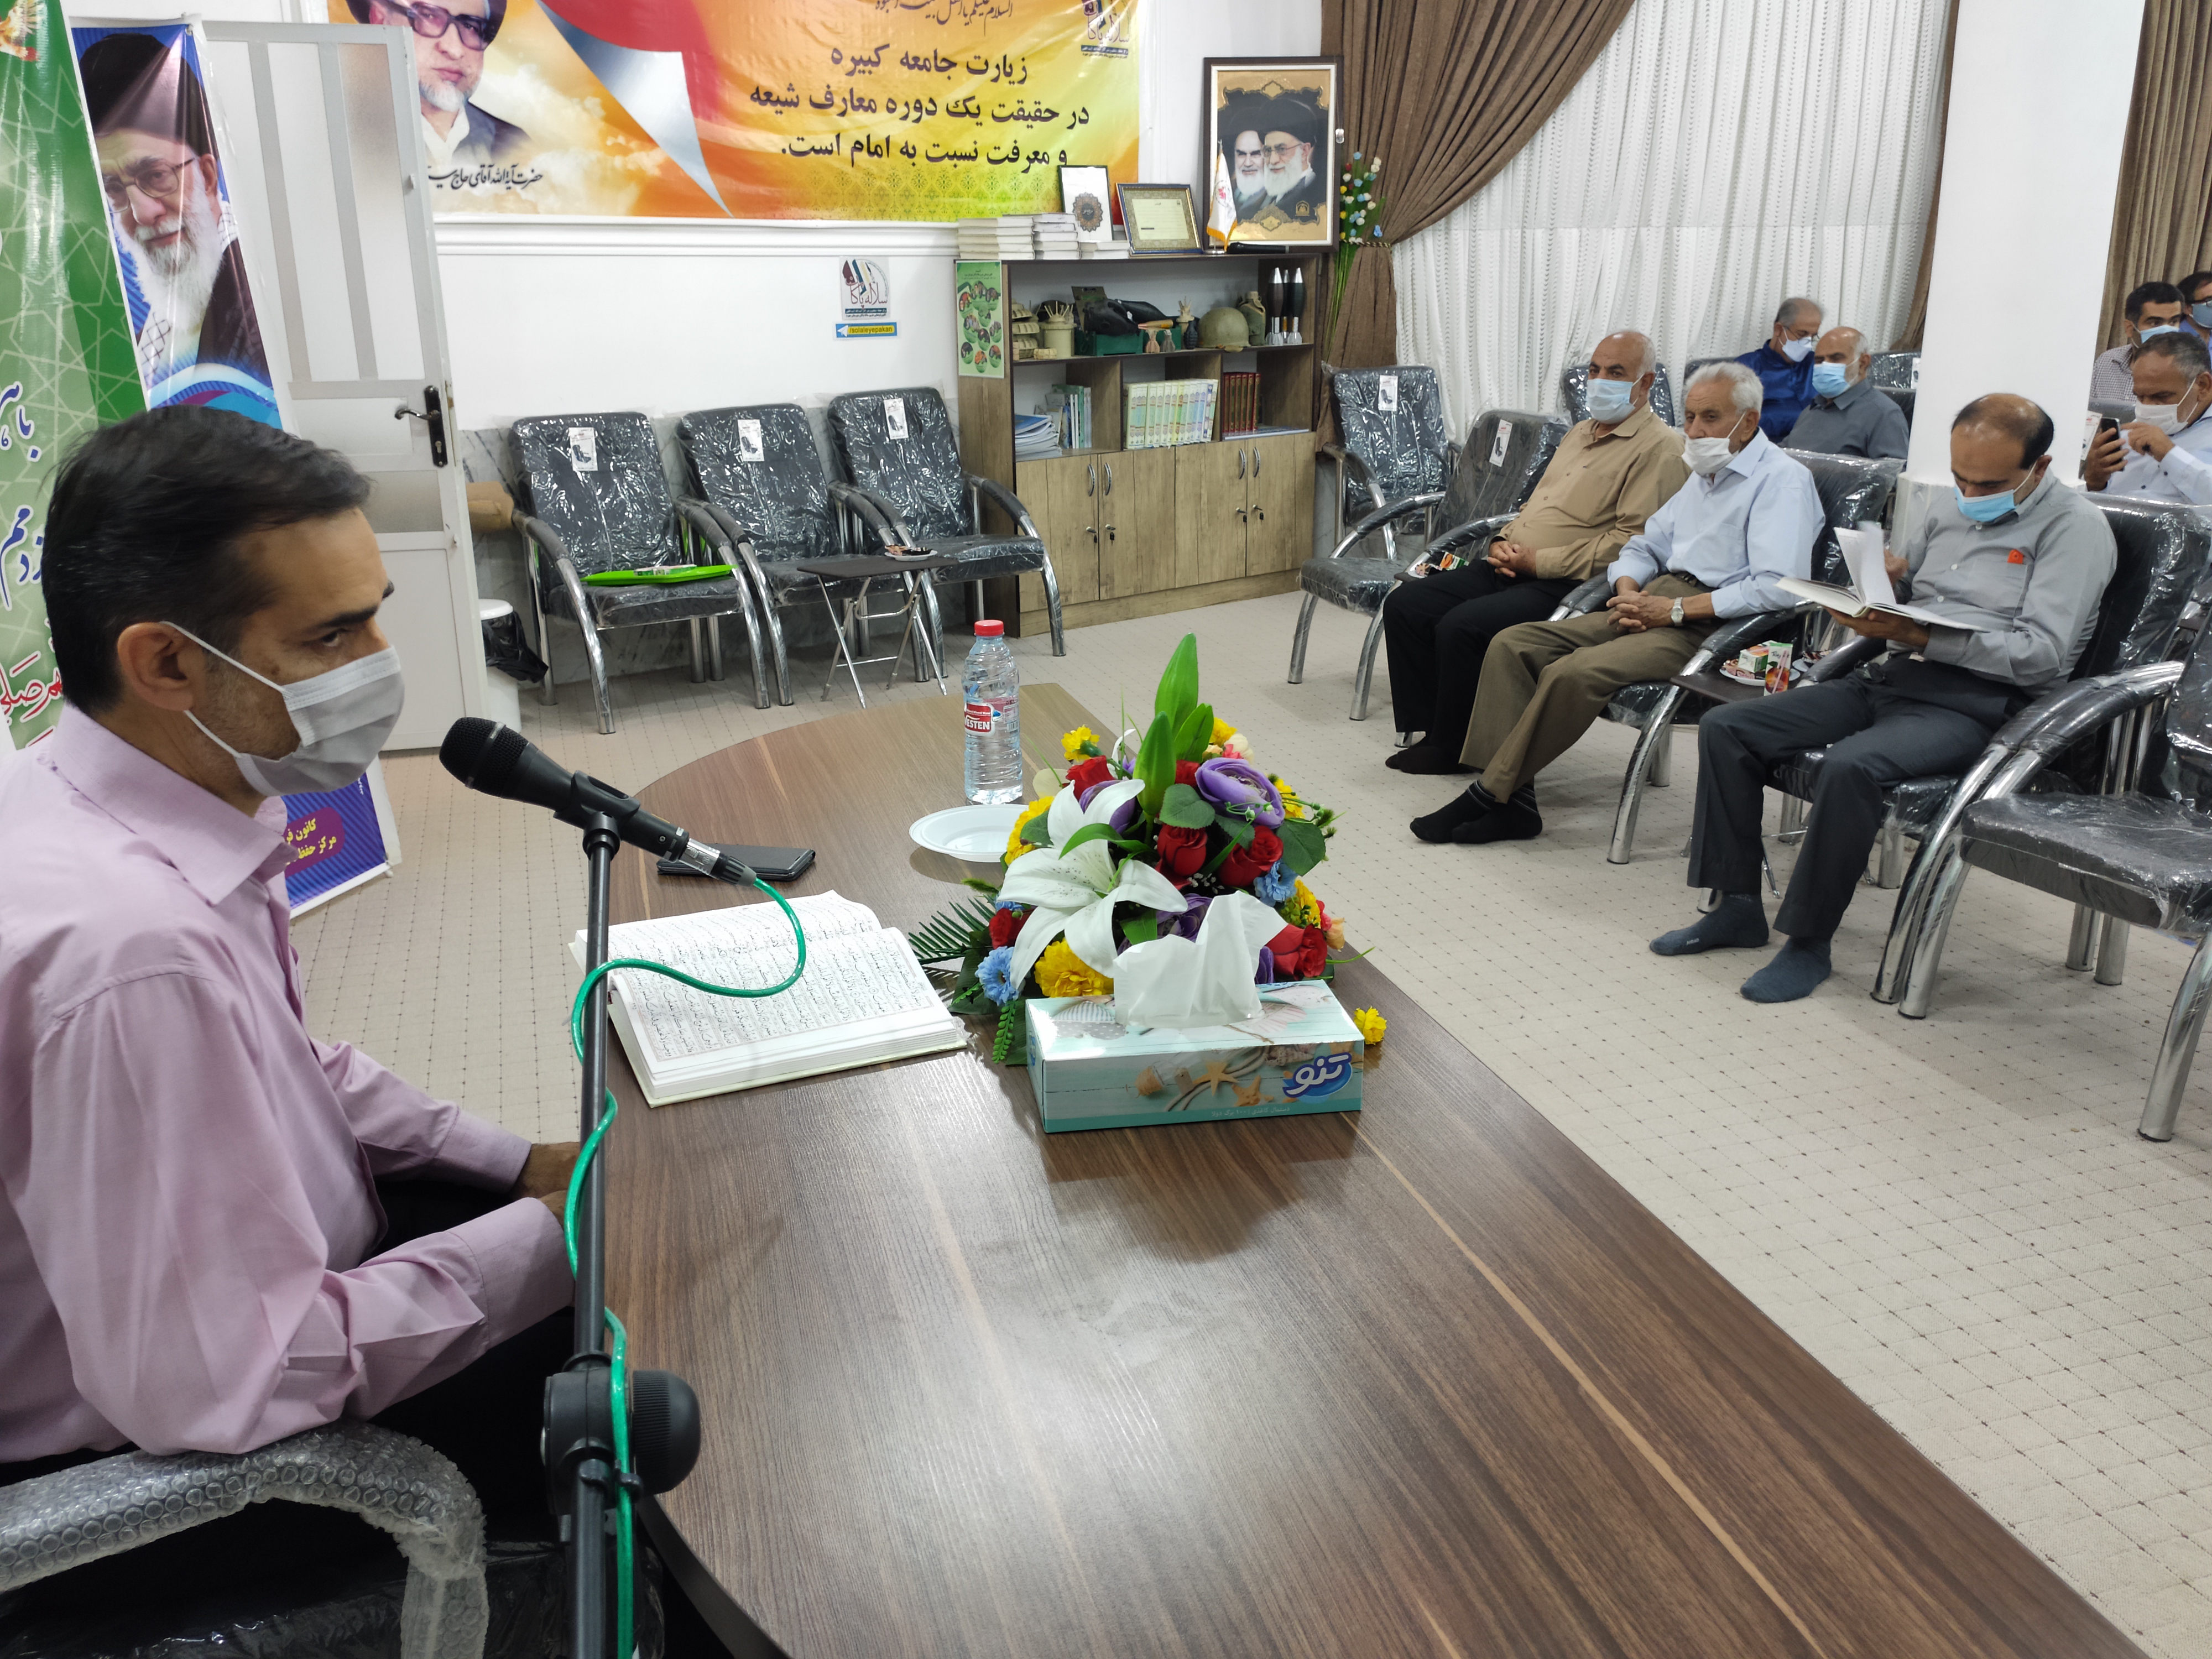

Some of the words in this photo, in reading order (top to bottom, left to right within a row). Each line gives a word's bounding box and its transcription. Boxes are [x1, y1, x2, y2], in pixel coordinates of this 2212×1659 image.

[831, 43, 890, 76] کبیره
[900, 48, 957, 80] جامعه
[966, 54, 1027, 85] زیارت
[750, 83, 800, 116] شیعه
[809, 84, 877, 117] معارف
[886, 97, 937, 124] دوره
[992, 99, 1060, 129] حقیقت
[1067, 106, 1089, 129] در
[781, 132, 841, 158] است.
[850, 133, 890, 168] امام
[900, 140, 917, 167] به
[925, 140, 978, 169] نسبت
[987, 139, 1050, 174] معرفت
[450, 168, 469, 190] حاج
[469, 164, 495, 187] آقای
[512, 169, 543, 190] حضرت
[295, 818, 316, 841] کانون
[317, 836, 337, 854] مرکز
[1284, 1052, 1351, 1097] تنو
